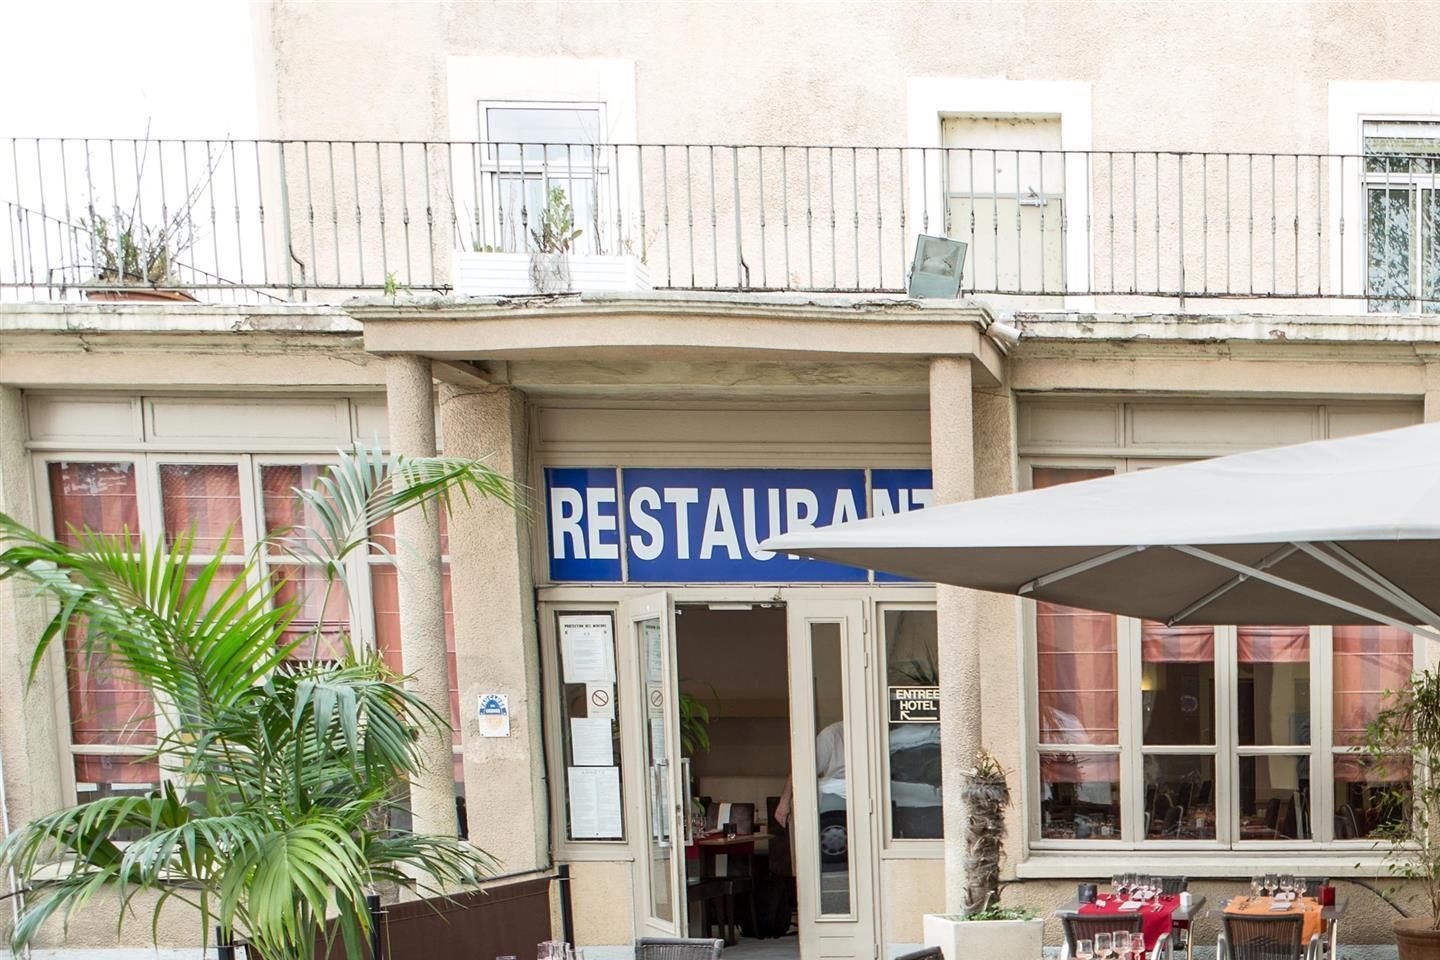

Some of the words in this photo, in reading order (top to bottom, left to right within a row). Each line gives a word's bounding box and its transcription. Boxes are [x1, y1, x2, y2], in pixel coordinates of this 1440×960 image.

[551, 487, 933, 561] RESTAURA
[896, 689, 940, 700] ENTREE
[900, 700, 937, 711] HOTEL
